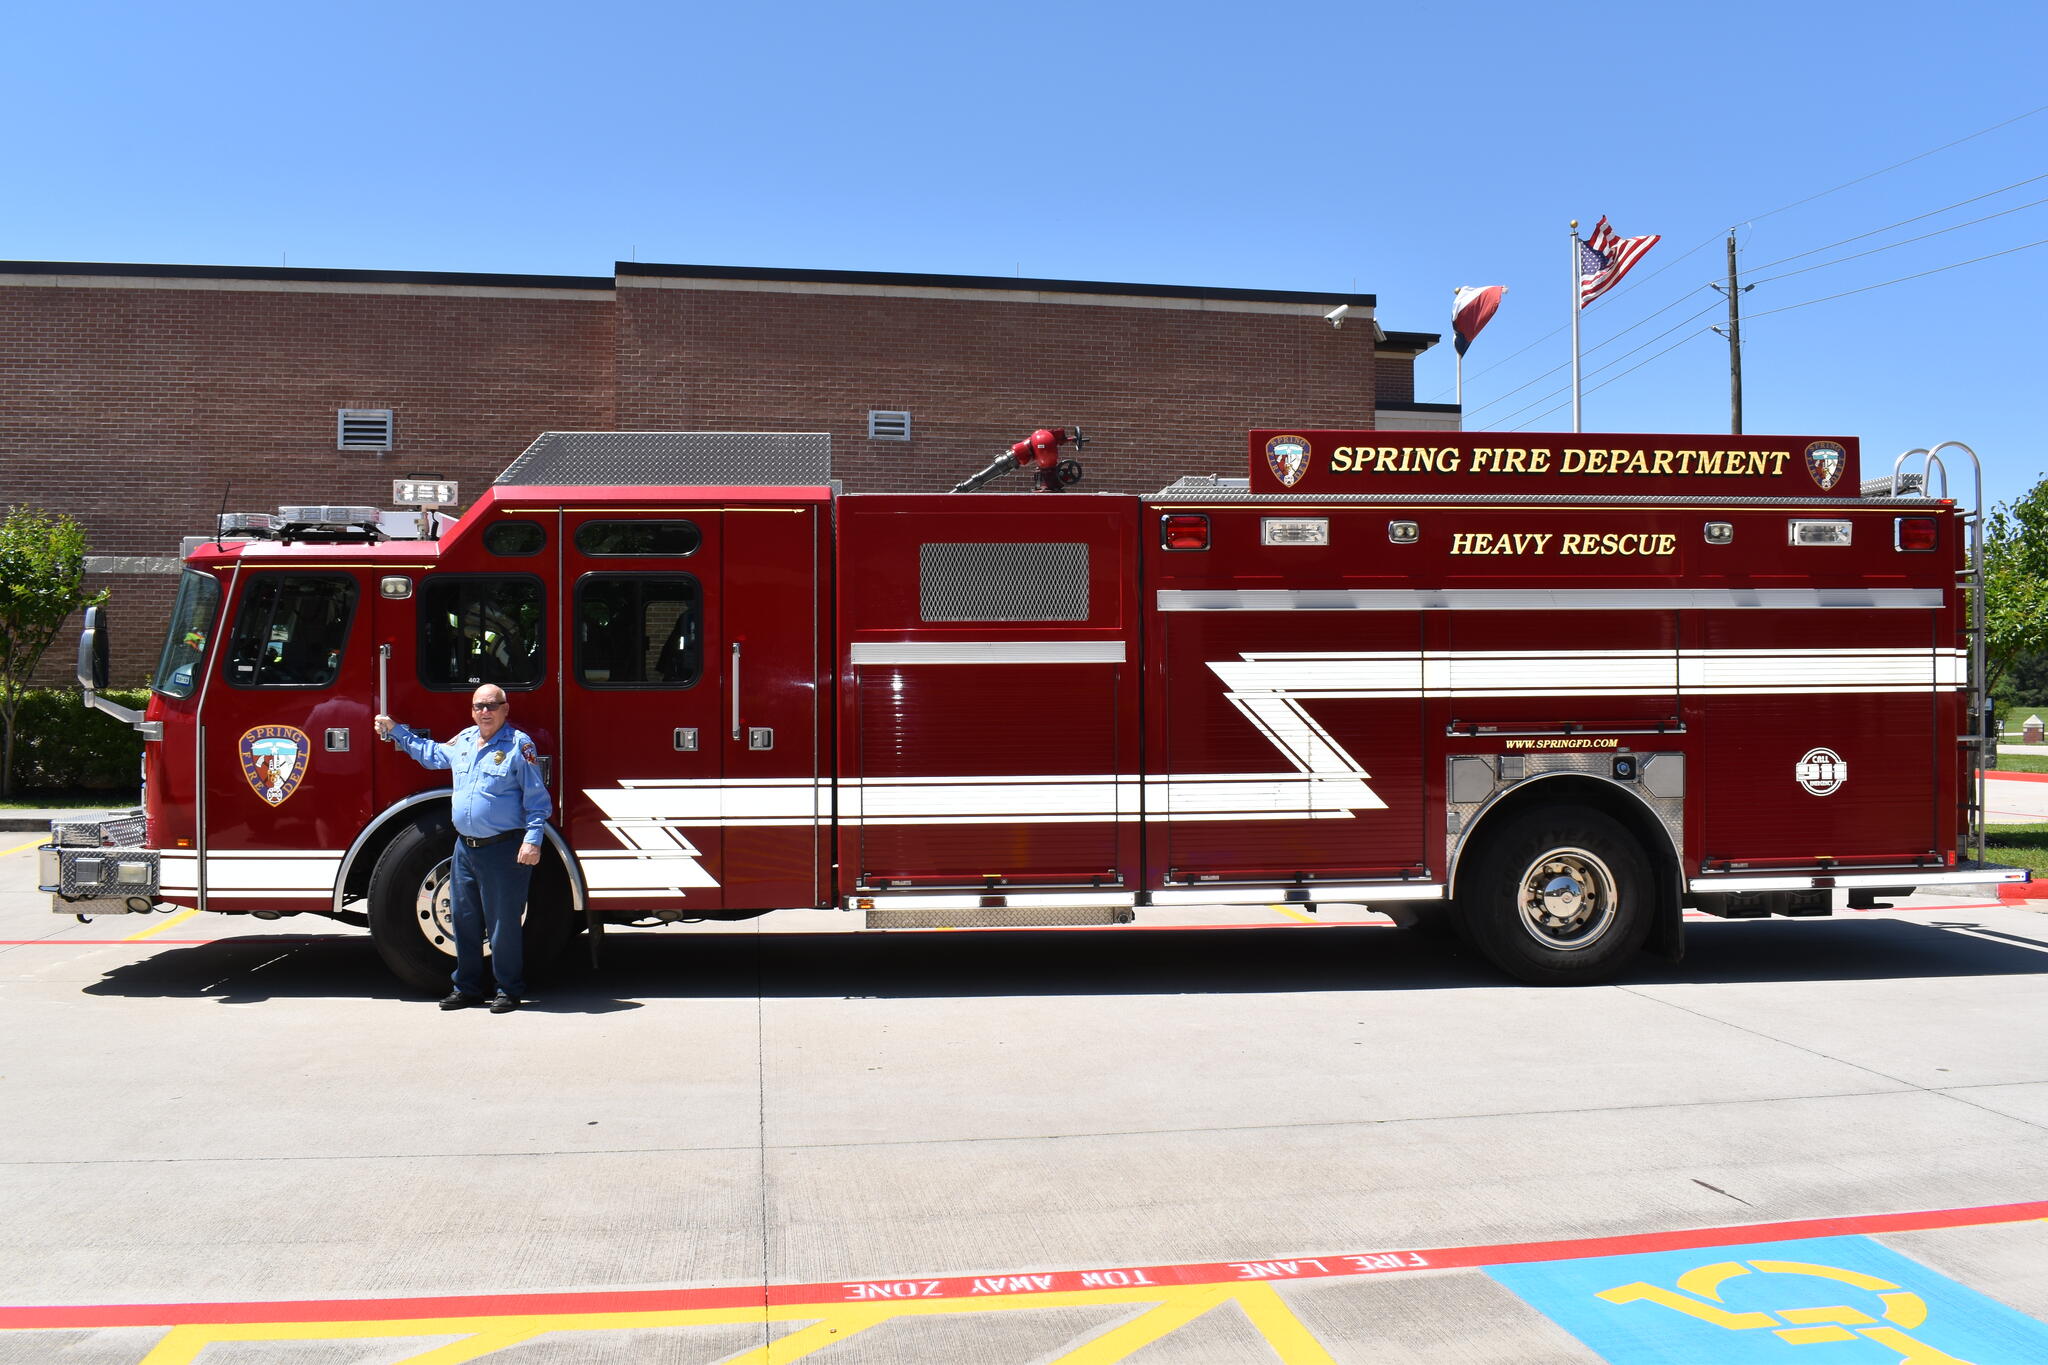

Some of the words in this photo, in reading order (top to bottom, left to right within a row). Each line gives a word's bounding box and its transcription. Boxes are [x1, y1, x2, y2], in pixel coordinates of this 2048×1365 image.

[1331, 446, 1461, 473] SPRING
[1469, 447, 1551, 474] FIRE
[1559, 448, 1791, 476] DEPARTMENT
[1449, 533, 1554, 556] HEAVY
[1559, 533, 1677, 556] RESCUE
[245, 727, 302, 743] SPRING
[1505, 738, 1619, 749] WWW.SPRINGFD.COM
[240, 751, 264, 791] FIRE
[282, 750, 307, 793] DEPT
[1228, 1259, 1329, 1279] LANE
[1343, 1252, 1430, 1271] FIRE
[971, 1275, 1053, 1294] AWAY
[1080, 1269, 1157, 1287] TOW
[842, 1280, 944, 1300] ZONE
